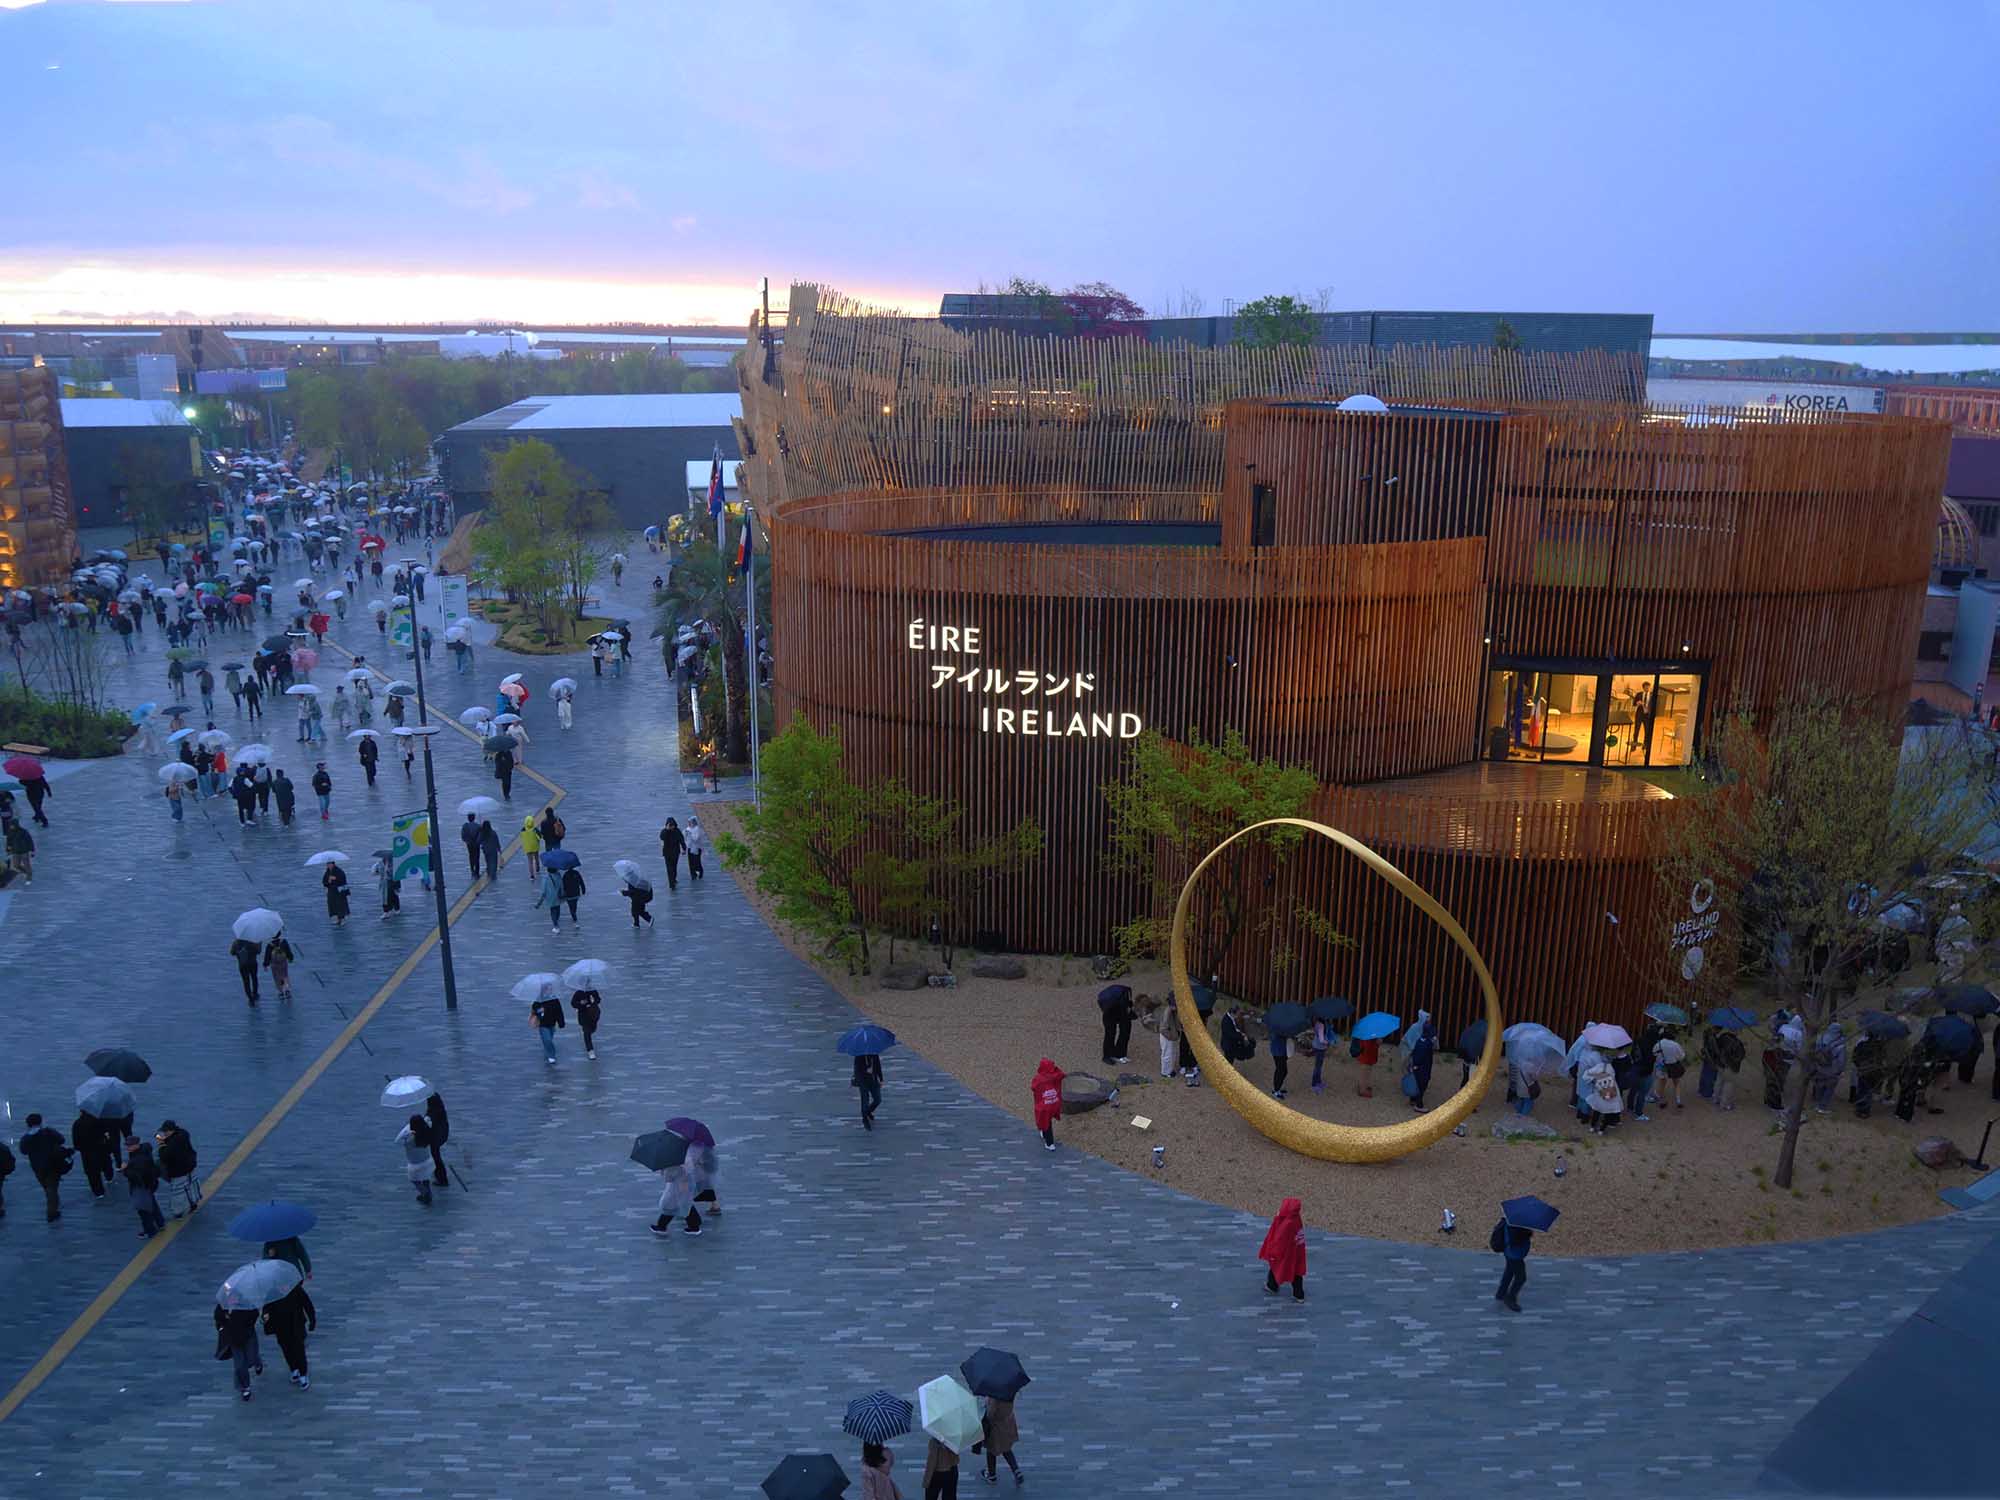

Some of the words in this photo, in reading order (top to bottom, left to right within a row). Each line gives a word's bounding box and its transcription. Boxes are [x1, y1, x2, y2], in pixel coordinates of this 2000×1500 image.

[1785, 394, 1849, 411] KOREA
[909, 618, 980, 654] ÉIRE
[931, 665, 1095, 698] アイルランド
[982, 707, 1142, 738] IRELAND
[1673, 911, 1720, 935] IRELAND
